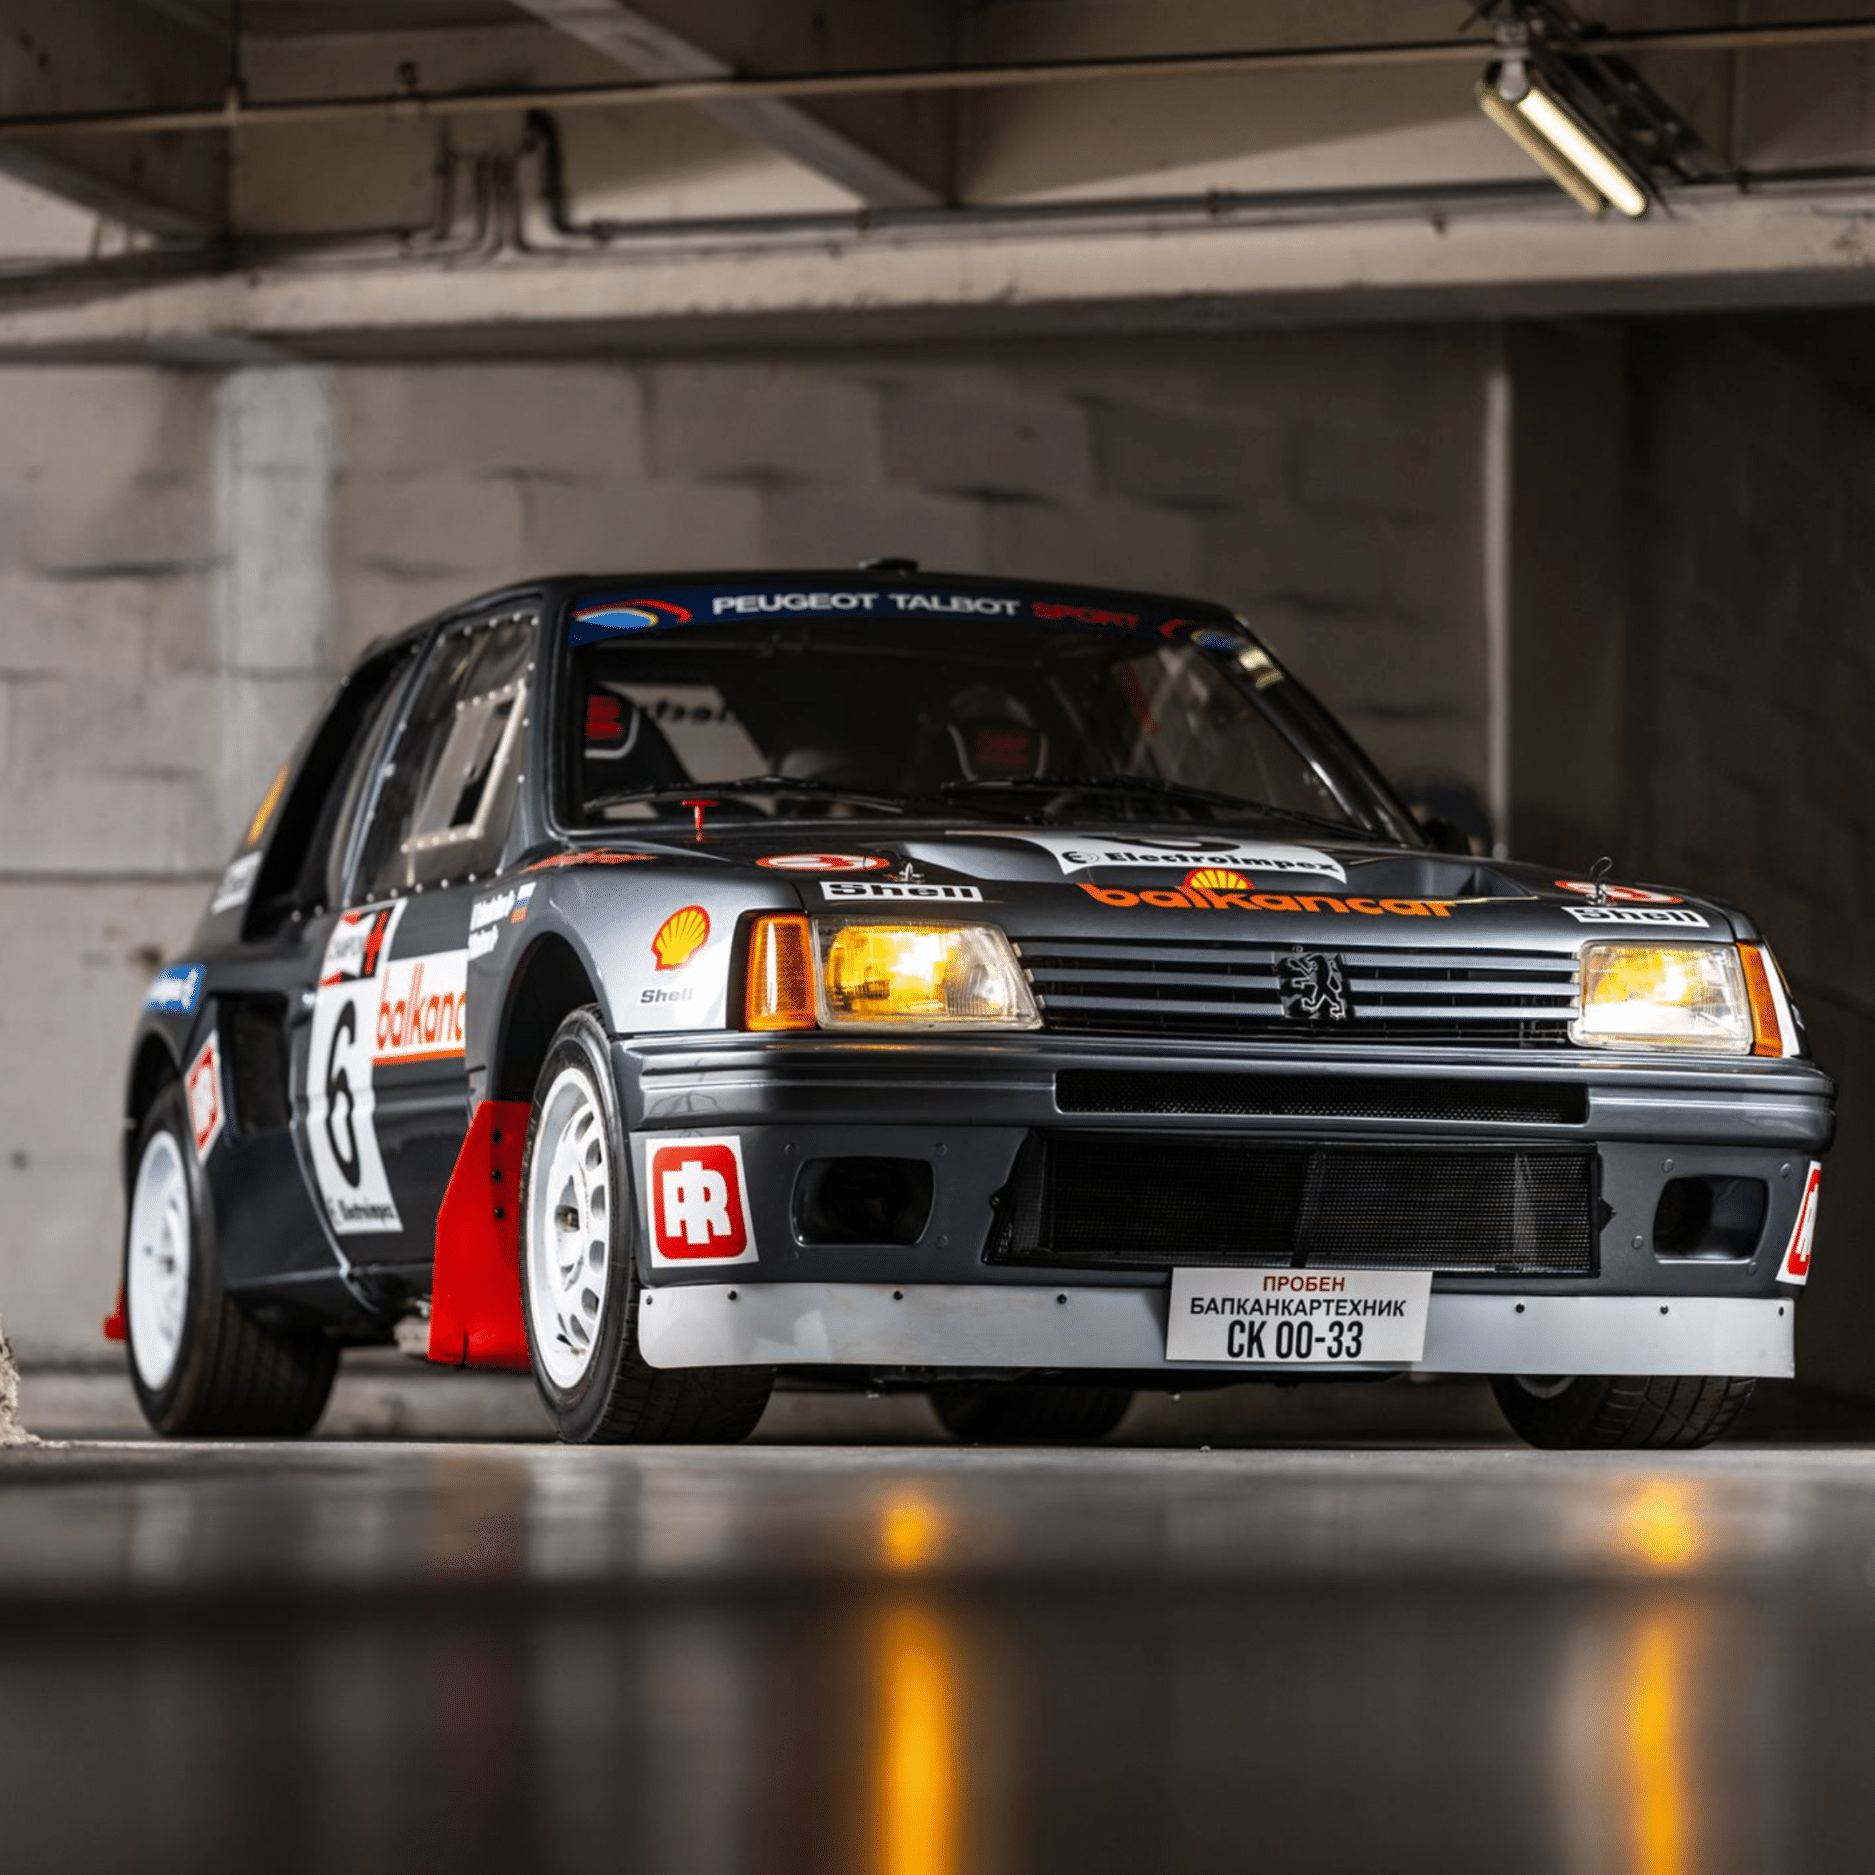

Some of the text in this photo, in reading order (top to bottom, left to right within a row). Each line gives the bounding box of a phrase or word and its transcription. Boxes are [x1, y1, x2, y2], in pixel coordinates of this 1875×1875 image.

[712, 592, 1140, 628] PEUGEOT TALBOT SPORT
[1104, 852, 1340, 873] Electroimpex
[829, 883, 974, 898] Shell
[1076, 883, 1458, 917] balkancar
[1573, 908, 1699, 923] Shell
[640, 988, 693, 1004] Shell
[326, 999, 361, 1189] 6
[1263, 1276, 1345, 1292] ПРОБЕН
[1190, 1297, 1406, 1317] БАПКАНКАРТЕХНИК
[1275, 1320, 1364, 1359] 00-33
